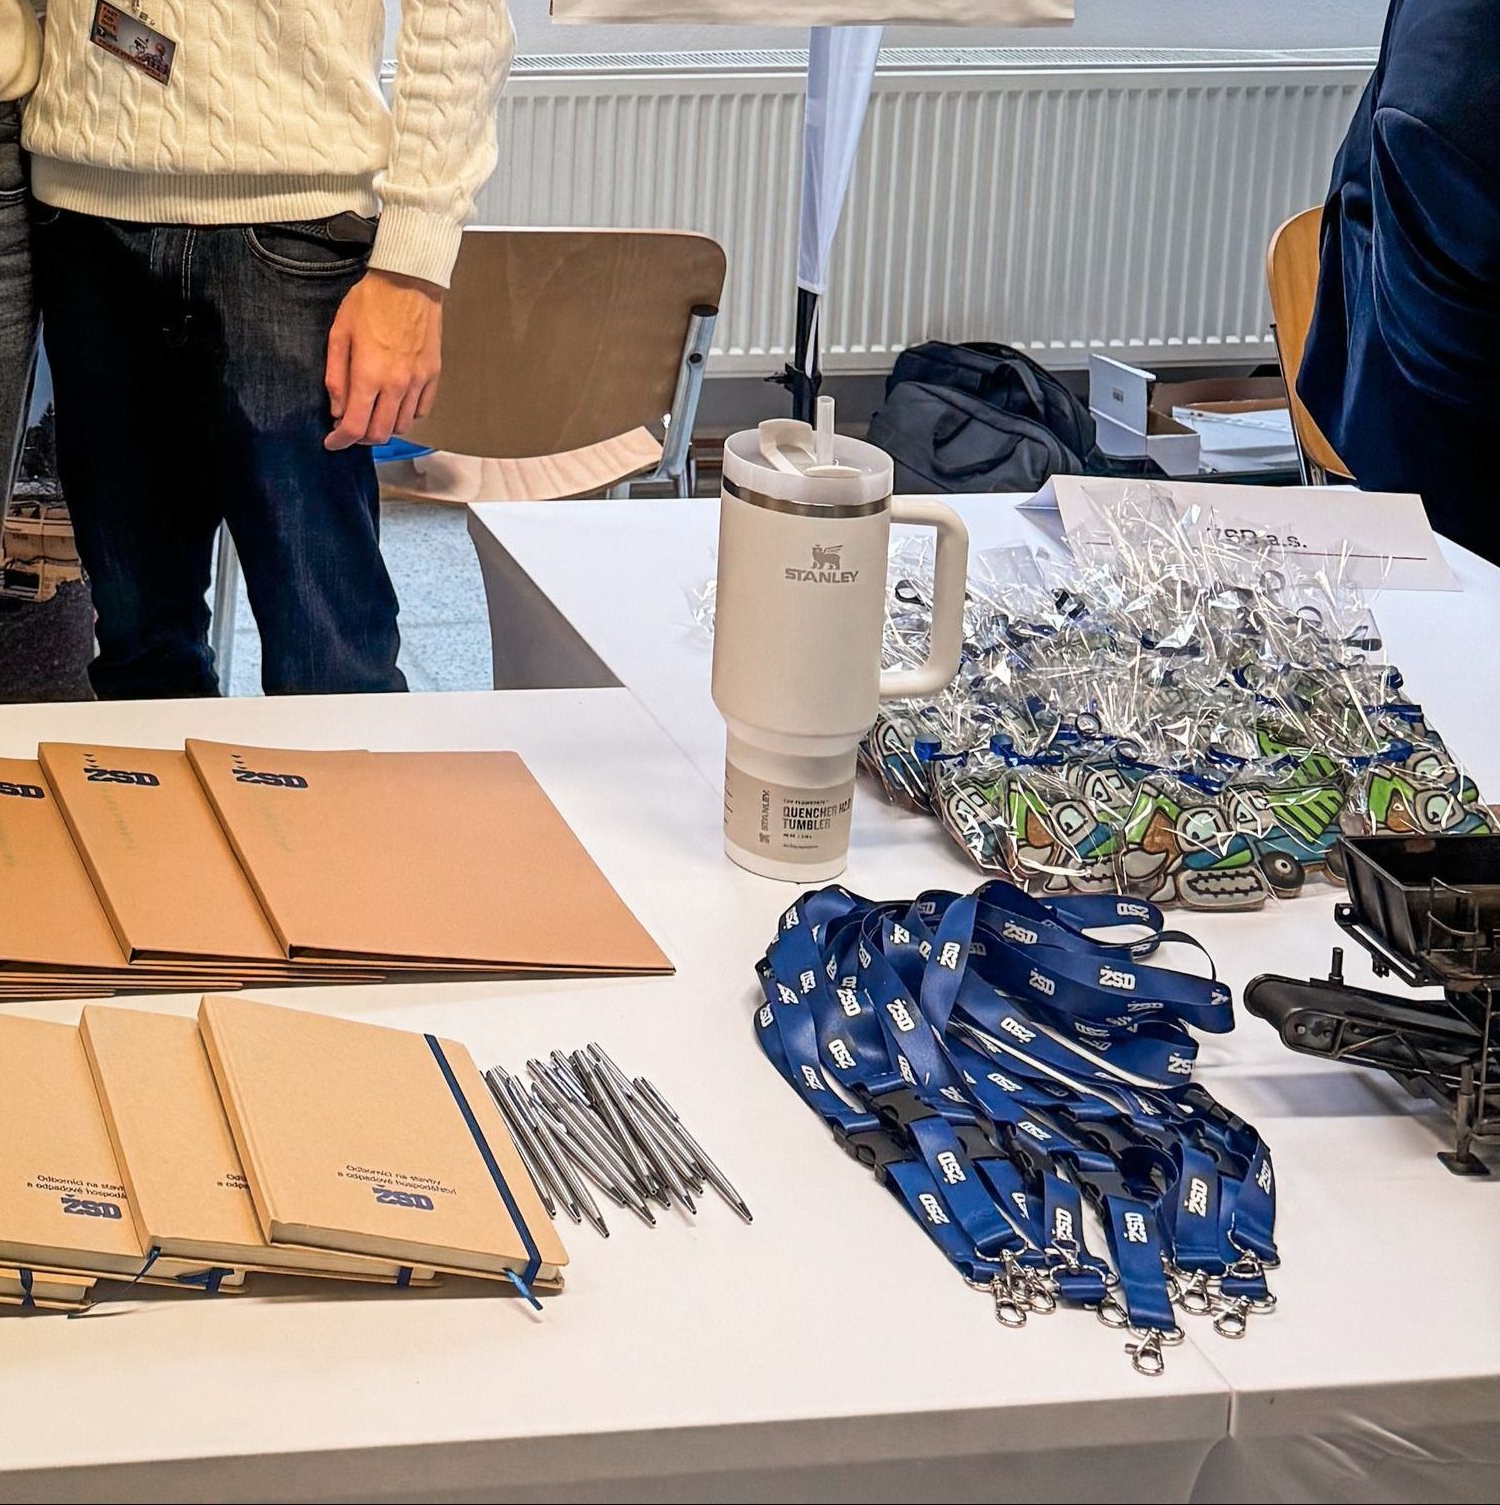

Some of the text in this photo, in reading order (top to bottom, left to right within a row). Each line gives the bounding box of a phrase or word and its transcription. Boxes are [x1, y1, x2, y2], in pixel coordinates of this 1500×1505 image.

[785, 568, 859, 584] STANLEY
[783, 805, 837, 818] QUENCHER
[783, 818, 831, 831] TUMBLER
[1099, 965, 1136, 990] ŽSD
[61, 1193, 122, 1219] ŽSD
[372, 1184, 434, 1211] ŽSD
